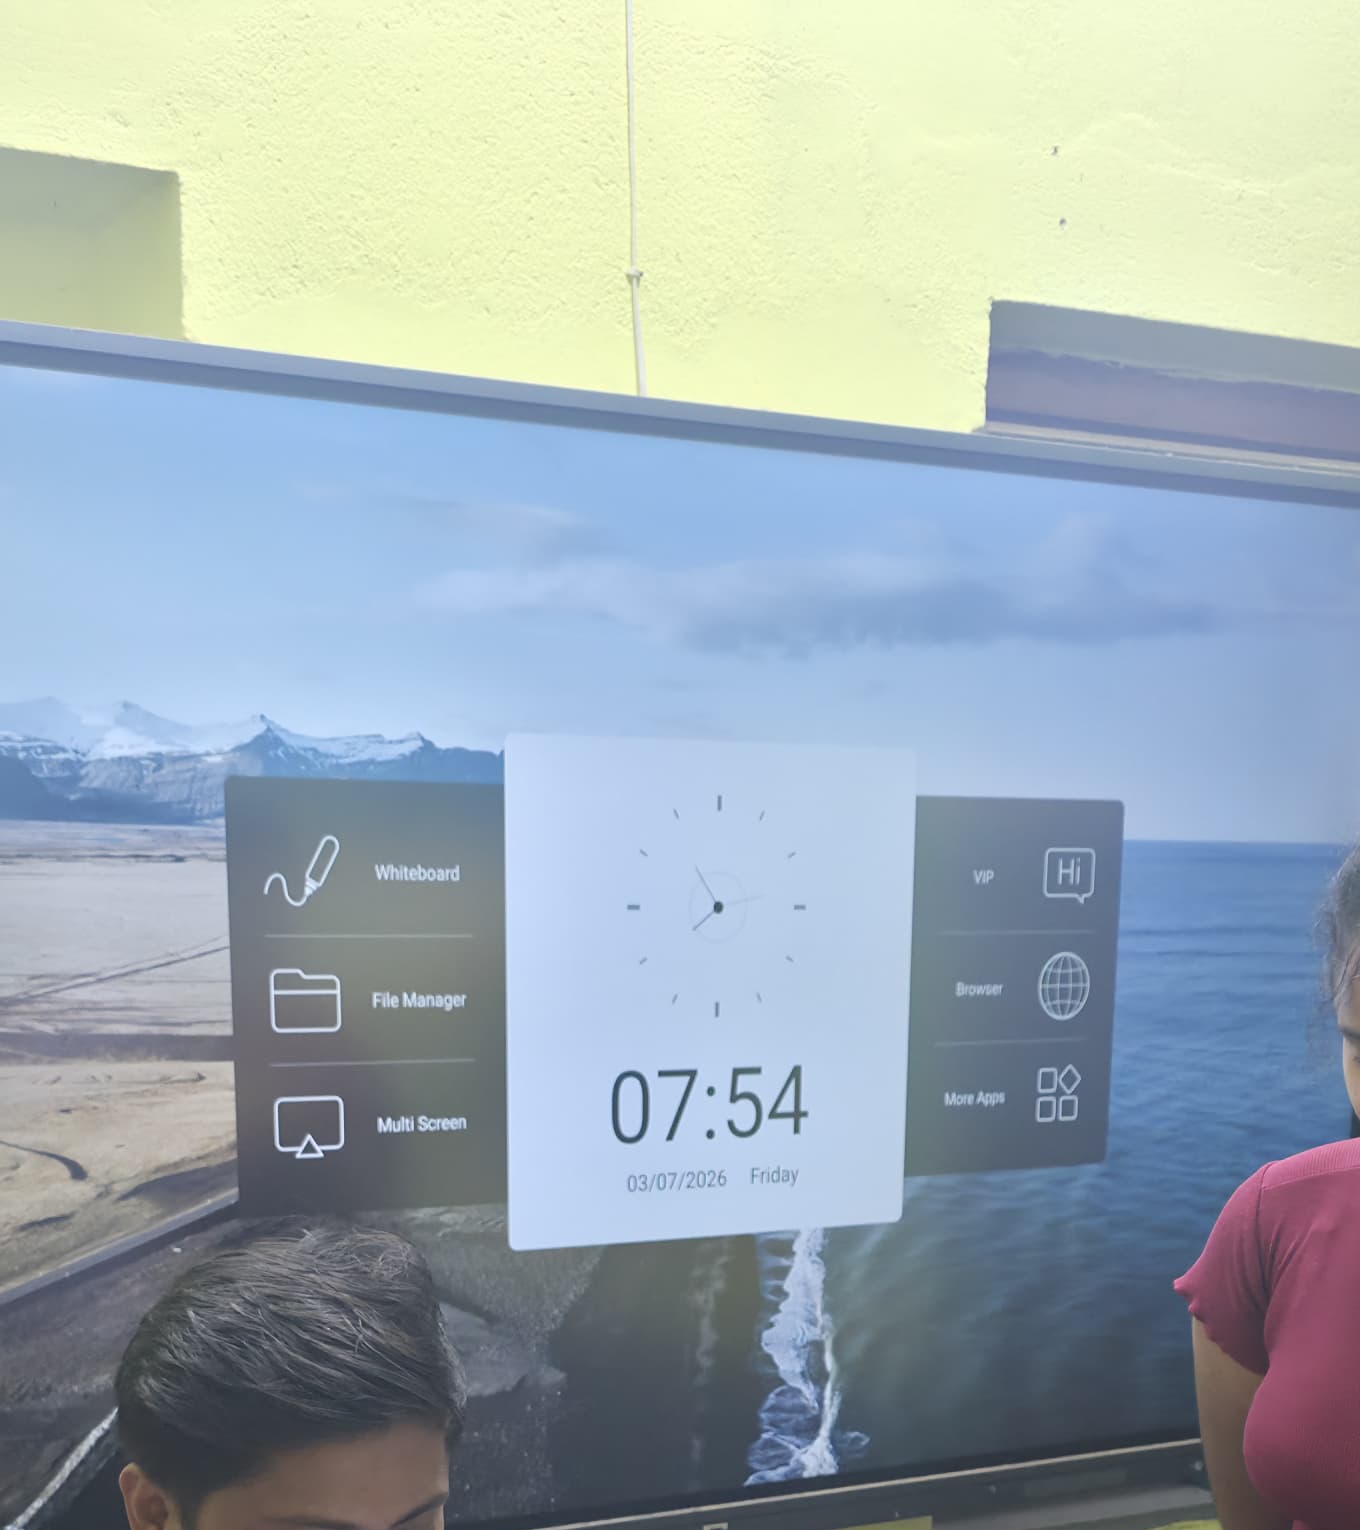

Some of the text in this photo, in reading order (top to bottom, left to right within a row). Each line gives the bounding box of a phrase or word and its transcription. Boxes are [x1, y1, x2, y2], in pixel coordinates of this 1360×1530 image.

[374, 863, 460, 881] Whiteboard
[973, 869, 994, 884] VIP
[1057, 857, 1081, 885] Hi
[955, 981, 1004, 998] Browser
[372, 991, 467, 1012] File Manager
[611, 1065, 809, 1144] 07:54
[943, 1090, 1006, 1107] More Apps
[376, 1115, 468, 1133] Multi Screen
[627, 1165, 800, 1193] 03/07/2026 Friday
